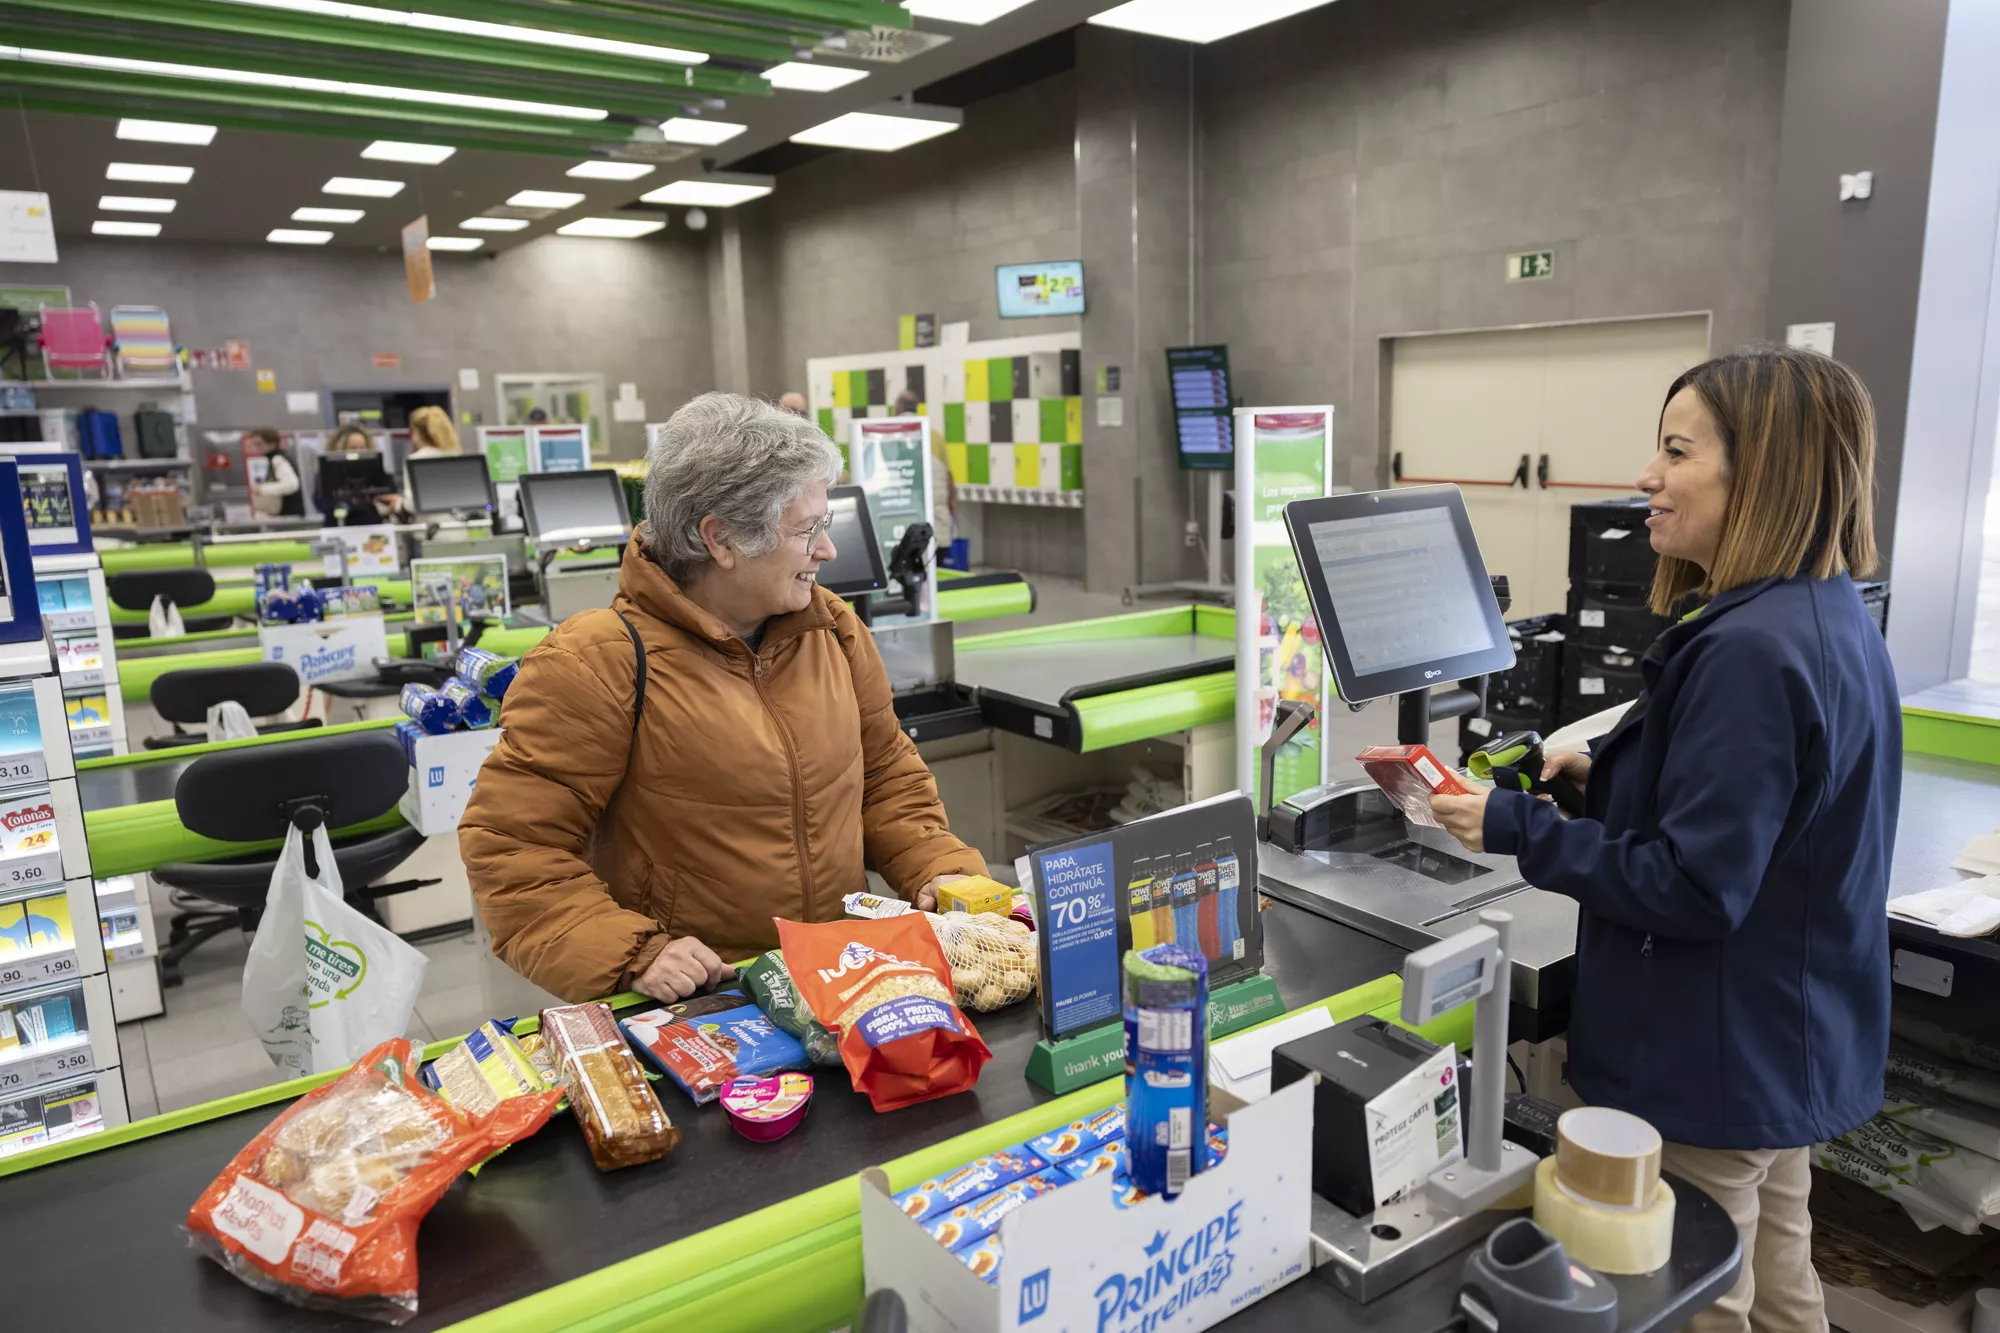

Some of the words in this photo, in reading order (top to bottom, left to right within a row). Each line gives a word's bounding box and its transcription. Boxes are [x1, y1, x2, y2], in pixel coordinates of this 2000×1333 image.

[1263, 487, 1278, 497] Los
[431, 770, 442, 782] LU
[8, 810, 51, 826] Coronas
[25, 834, 46, 847] 24
[1045, 857, 1077, 872] PARA.
[1218, 863, 1236, 873] OWER
[12, 867, 42, 881] 3,60
[1048, 863, 1105, 885] HIDRÁTATE.
[1198, 869, 1216, 880] OWER
[1049, 876, 1105, 899] CONTINÚA.
[1131, 886, 1150, 897] POWE
[1153, 877, 1171, 890] POWE
[1173, 879, 1196, 891] POWER
[308, 941, 326, 959] me
[327, 954, 354, 976] tires,
[0, 970, 21, 984] ,90
[43, 960, 71, 974] 1,90
[322, 966, 341, 983] una
[894, 997, 926, 1010] contenido
[1056, 996, 1073, 1007] PAUSE
[1079, 990, 1097, 1000] POWER
[1228, 994, 1274, 1015] HiperDino
[866, 1014, 898, 1033] FIBRA
[876, 1018, 908, 1036] 100%
[1064, 1055, 1100, 1076] thank
[1102, 1048, 1125, 1067] you
[1887, 1052, 1942, 1078] egunda
[0, 1074, 20, 1089] ,70
[57, 1055, 86, 1070] 3,50
[1892, 1067, 1923, 1084] vida
[1409, 1102, 1430, 1123] CARTE
[1857, 1128, 1908, 1158] egunda
[1859, 1141, 1887, 1161] vida
[1825, 1144, 1889, 1177] segunda
[1838, 1163, 1870, 1182] vida
[1094, 1200, 1243, 1333] PRINCIPE
[1023, 1278, 1046, 1317] LU
